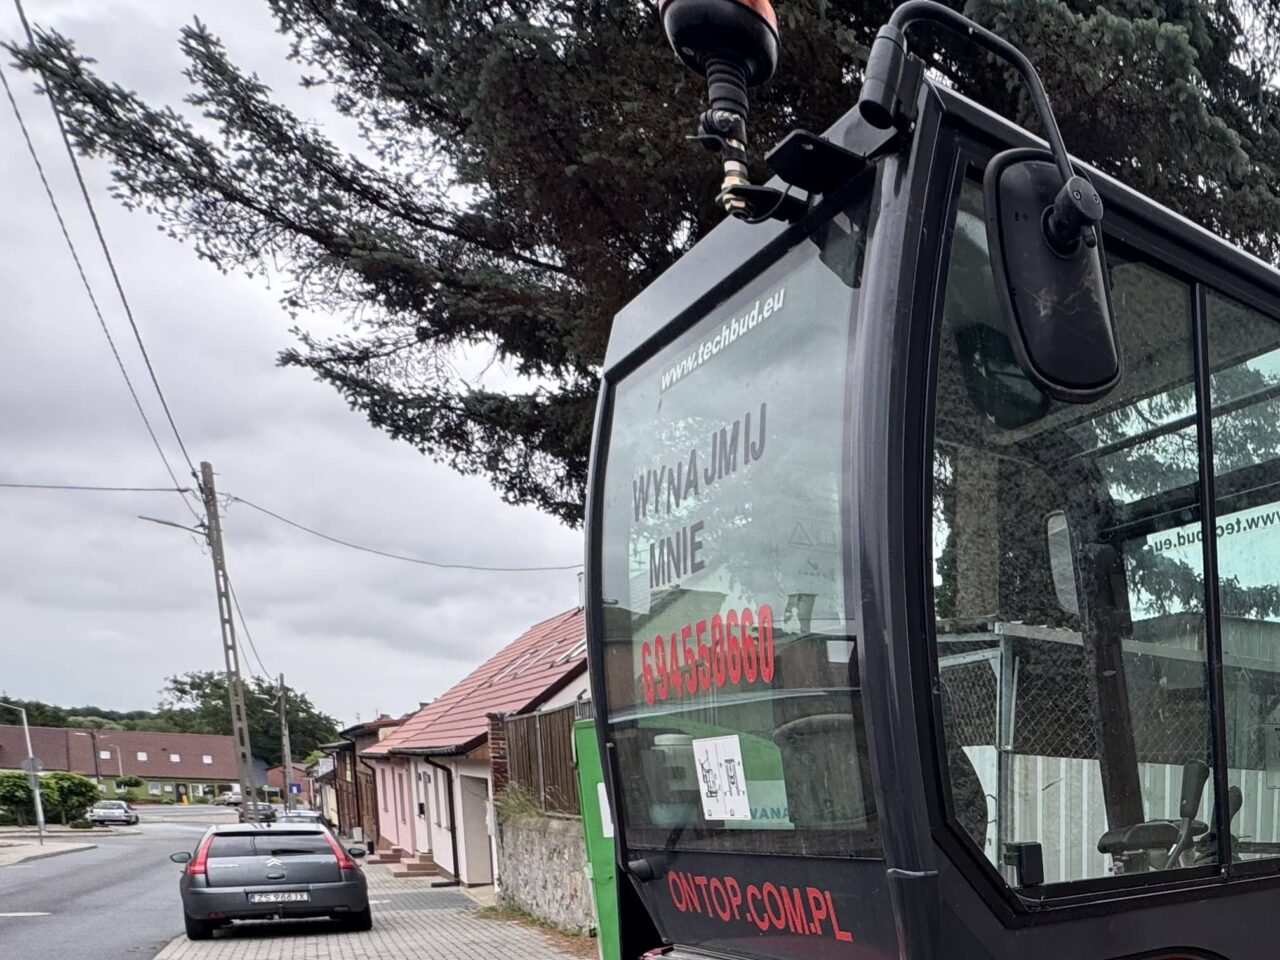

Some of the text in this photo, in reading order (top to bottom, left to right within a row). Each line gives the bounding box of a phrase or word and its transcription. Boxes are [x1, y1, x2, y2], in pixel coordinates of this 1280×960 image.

[660, 288, 785, 391] www.techbud.eu
[650, 520, 705, 589] MNIE
[667, 870, 853, 942] ONTOP.COM.PL
